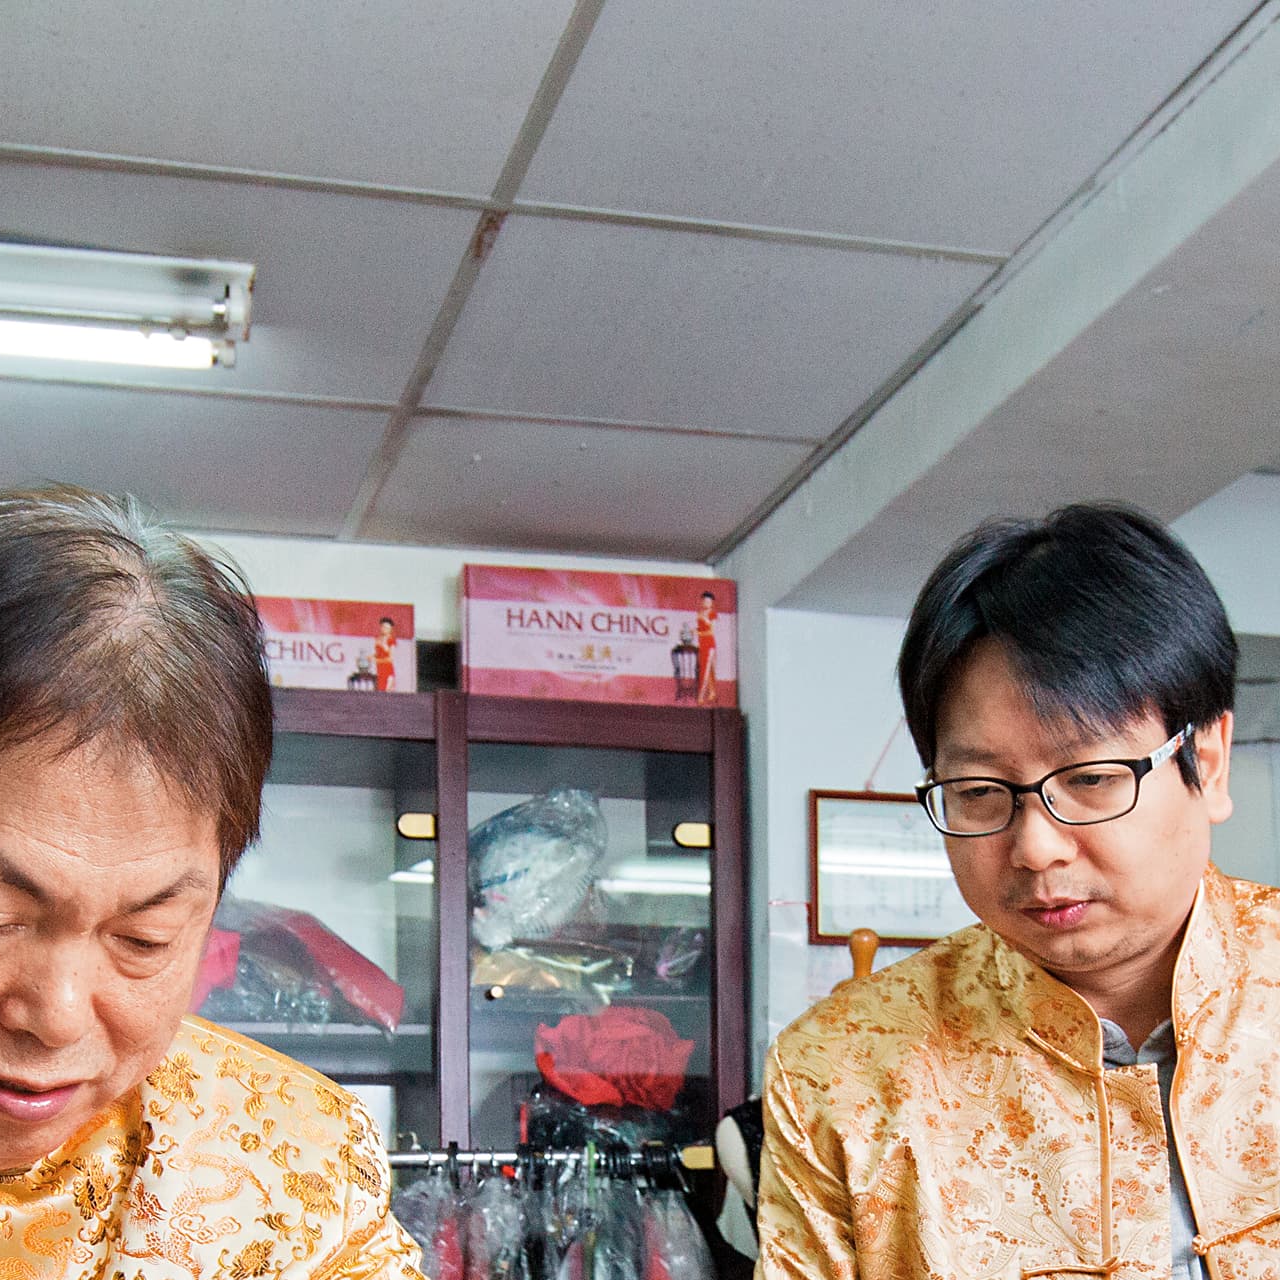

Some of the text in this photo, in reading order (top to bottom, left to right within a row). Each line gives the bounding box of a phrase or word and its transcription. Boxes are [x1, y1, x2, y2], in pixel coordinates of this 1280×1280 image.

[506, 608, 583, 631] HANN
[591, 611, 669, 637] CHING
[262, 639, 345, 664] CHING
